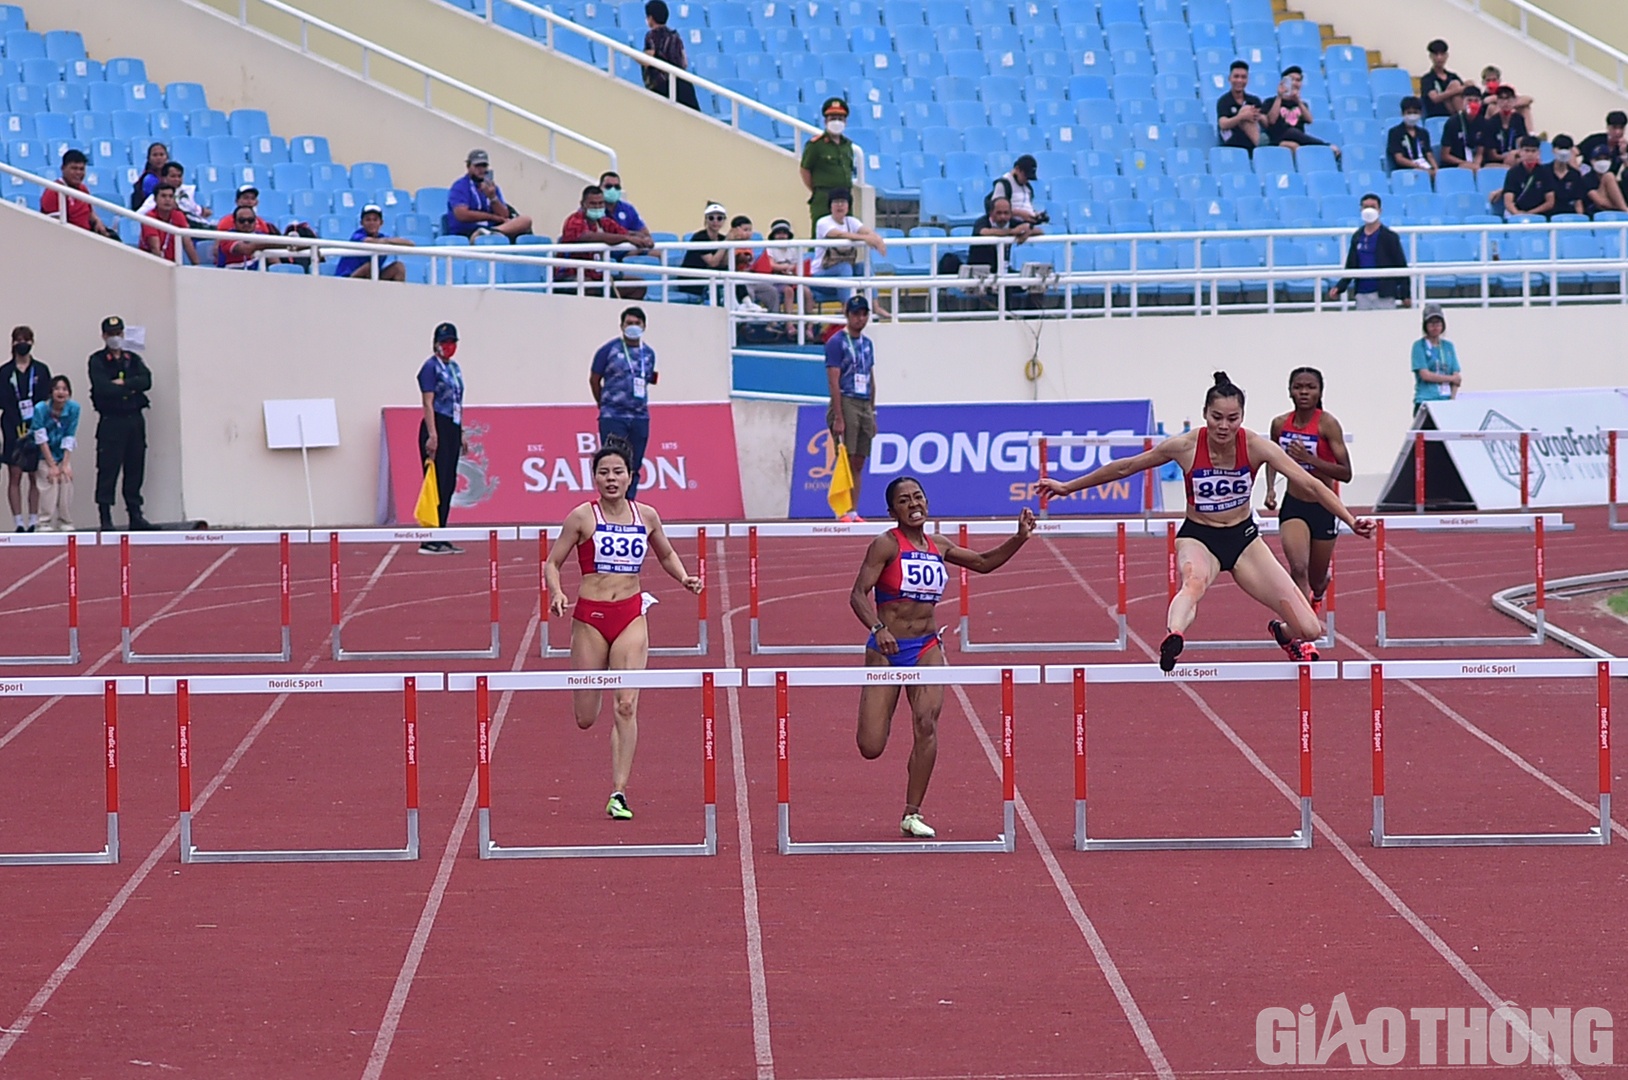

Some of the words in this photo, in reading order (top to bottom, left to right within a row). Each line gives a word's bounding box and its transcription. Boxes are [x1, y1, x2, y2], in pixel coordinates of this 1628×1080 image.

[1198, 479, 1248, 498] 866
[600, 536, 644, 558] 836
[907, 565, 943, 587] 501
[1193, 668, 1217, 679] Sport
[1492, 664, 1516, 675] Sport
[597, 675, 621, 686] Sport
[896, 672, 920, 683] Sport
[0, 683, 23, 693] Sport
[298, 680, 323, 689] Sport
